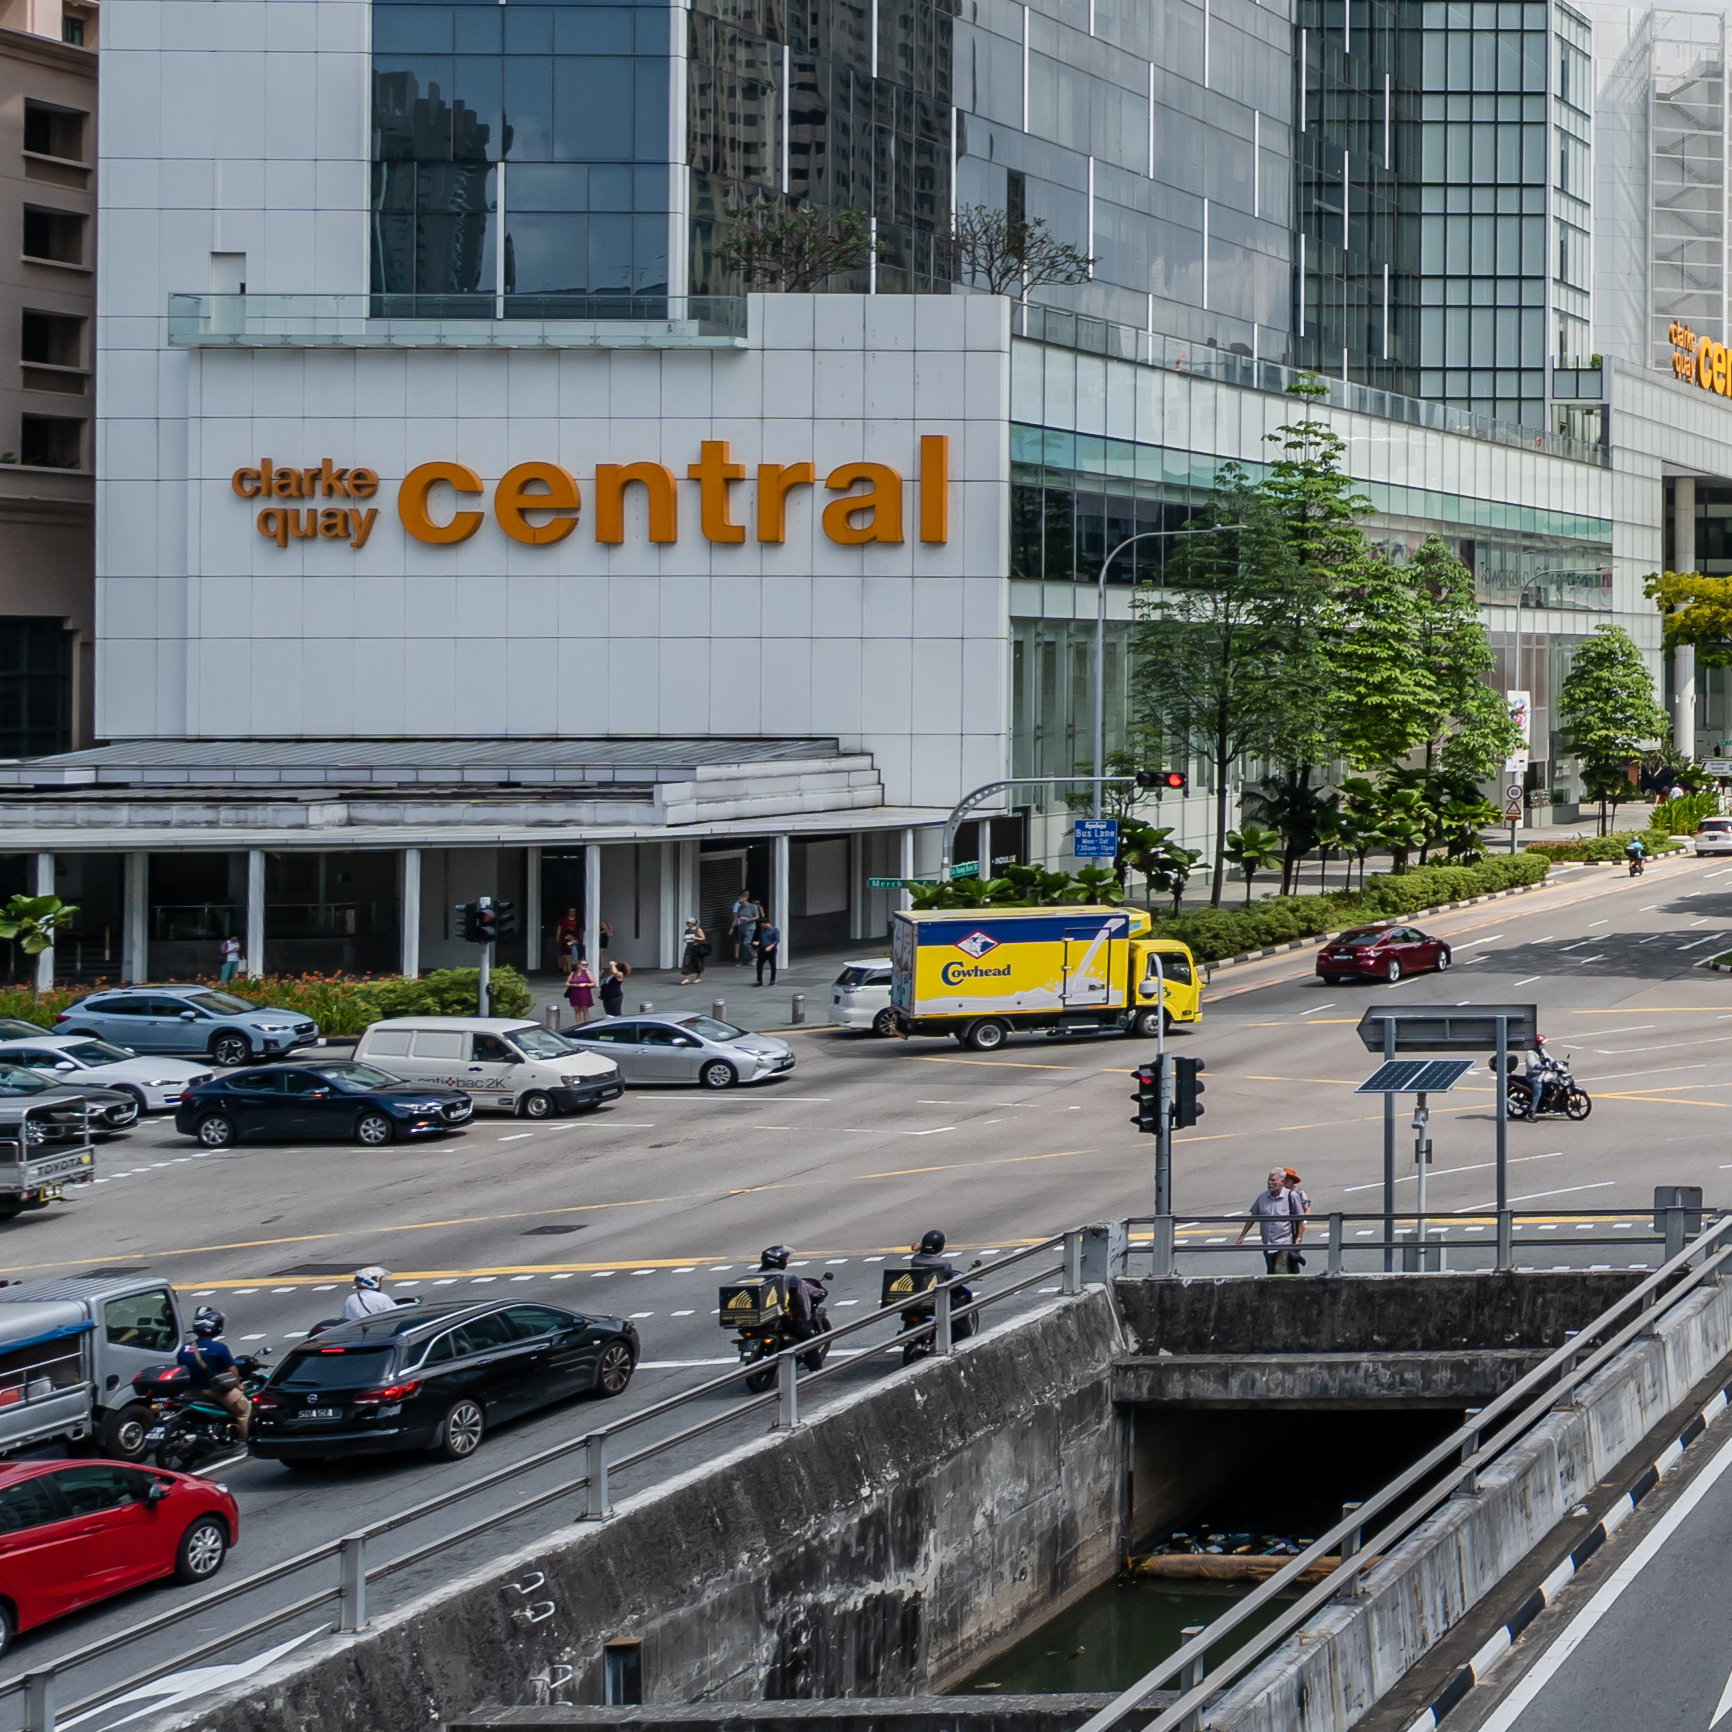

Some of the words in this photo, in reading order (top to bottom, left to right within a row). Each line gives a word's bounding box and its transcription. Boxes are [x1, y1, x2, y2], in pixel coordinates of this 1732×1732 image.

[1669, 320, 1696, 352] clarke
[1672, 352, 1696, 383] quay
[232, 457, 379, 499] clarke
[397, 434, 948, 545] central
[256, 505, 379, 549] quay
[1075, 828, 1091, 838] Bus
[1094, 828, 1115, 838] Lane
[941, 961, 1011, 986] Cowhead
[37, 1157, 83, 1176] TOYOTA
